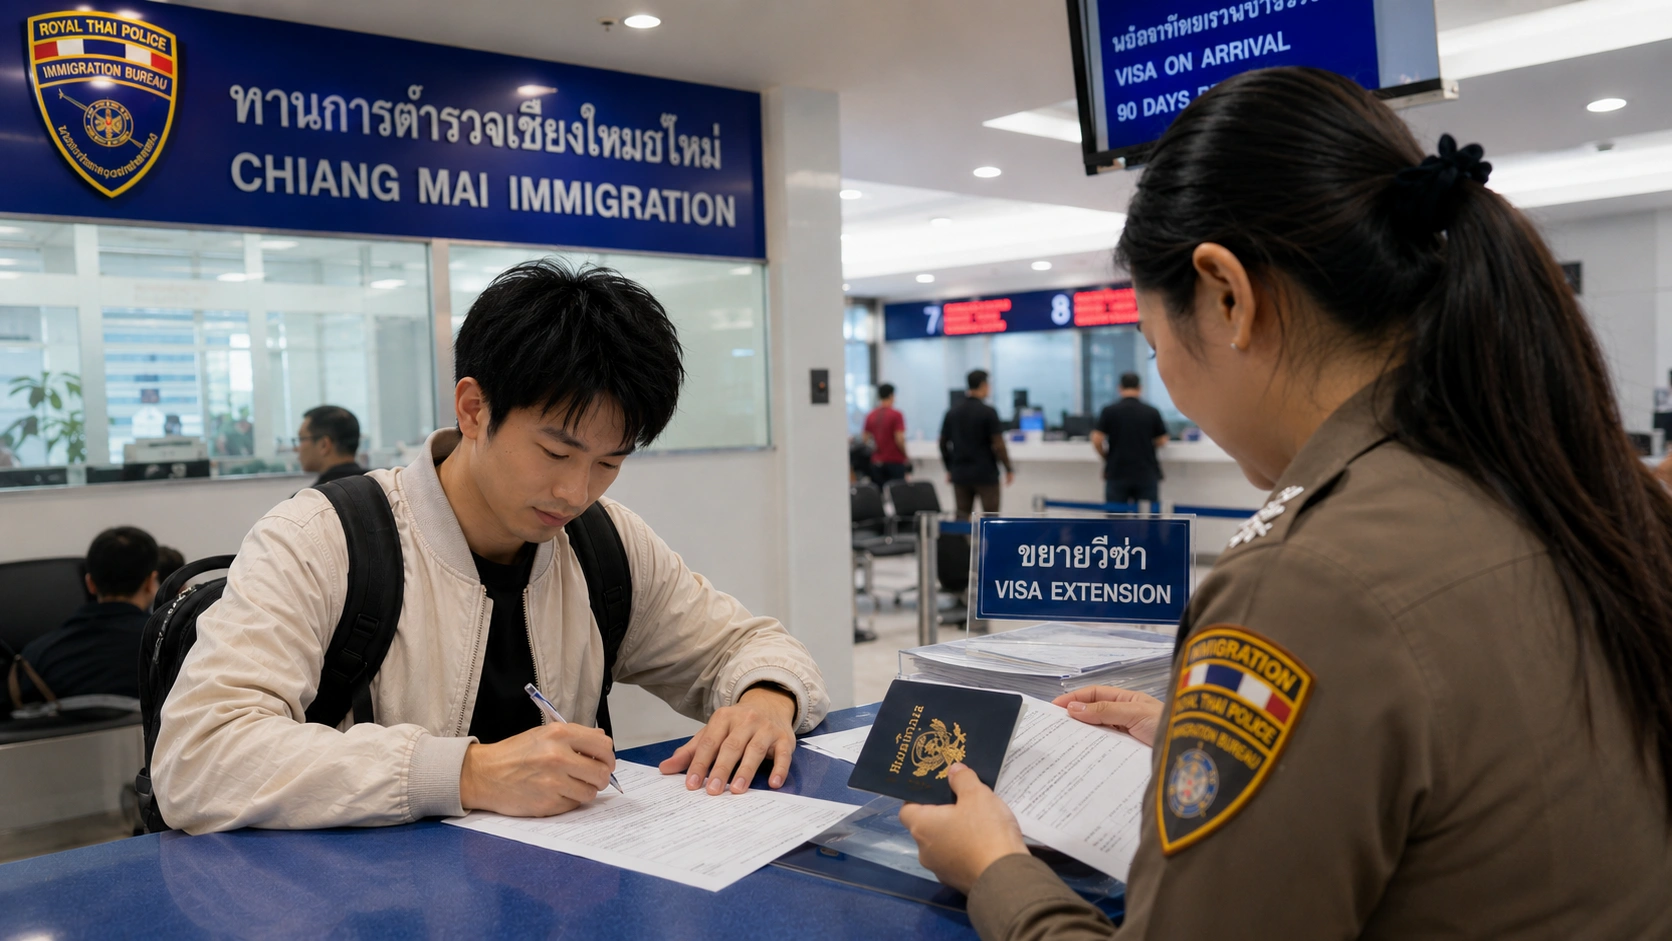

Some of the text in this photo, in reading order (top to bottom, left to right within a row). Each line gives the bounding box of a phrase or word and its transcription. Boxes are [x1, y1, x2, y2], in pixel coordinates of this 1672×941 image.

[39, 19, 167, 51] ROYAL THAI POLICE
[1115, 30, 1292, 86] VISA ON ARRIVAL
[42, 62, 168, 91] IMMIGRATION BUREAU
[1117, 101, 1138, 123] 90
[1143, 90, 1191, 117] DAYS
[230, 151, 736, 228] CHIANG MAI IMMIGRATION
[923, 305, 942, 335] 7
[1051, 293, 1071, 326] 8
[1018, 535, 1147, 570] ขยายวีซ่า
[994, 580, 1172, 604] VISA EXTENSION
[1226, 701, 1278, 746] POLICE
